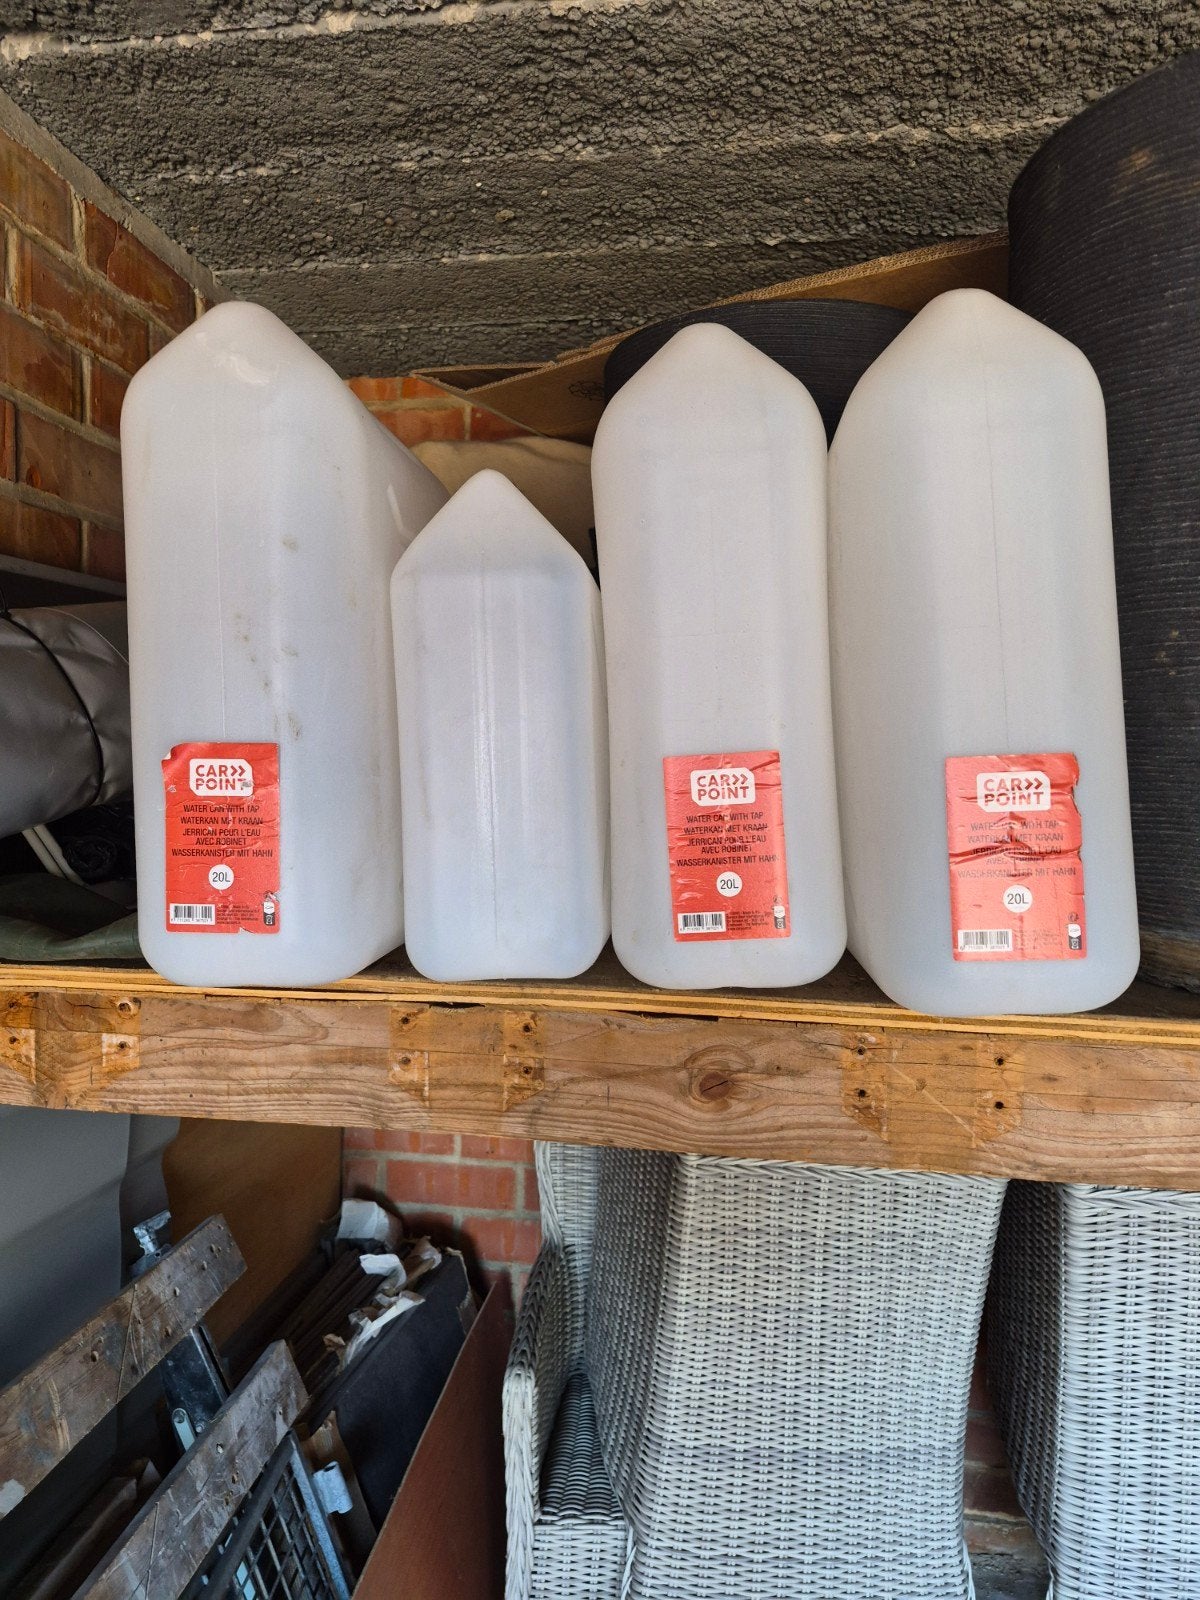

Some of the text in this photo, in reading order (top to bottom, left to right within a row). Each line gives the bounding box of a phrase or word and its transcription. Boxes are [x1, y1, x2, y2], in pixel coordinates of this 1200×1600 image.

[195, 764, 228, 777] CAR
[195, 778, 246, 791] POINT
[697, 774, 731, 788] CAR
[984, 777, 1022, 792] CAR
[697, 786, 749, 800] POINT
[984, 792, 1044, 806] POINT
[184, 805, 208, 813] WATER
[181, 816, 219, 825] WATERKAN
[686, 814, 711, 823] WATER
[730, 812, 748, 821] WITH
[751, 811, 764, 820] TAP
[183, 828, 217, 837] JERRICAN
[241, 828, 261, 837] L'EAU
[195, 837, 214, 846] AVEC
[687, 836, 723, 847] JERRICAN
[172, 848, 273, 858] WASSERKANISTER MIT HAHN
[701, 846, 720, 855] AVEC
[677, 856, 742, 867] WASSERKANISTER
[744, 855, 757, 864] MIT
[212, 871, 231, 883] 20L
[1035, 868, 1050, 877] MIT
[1052, 867, 1076, 876] HAHN
[720, 879, 739, 890] 20L
[1007, 893, 1029, 905] 20L
